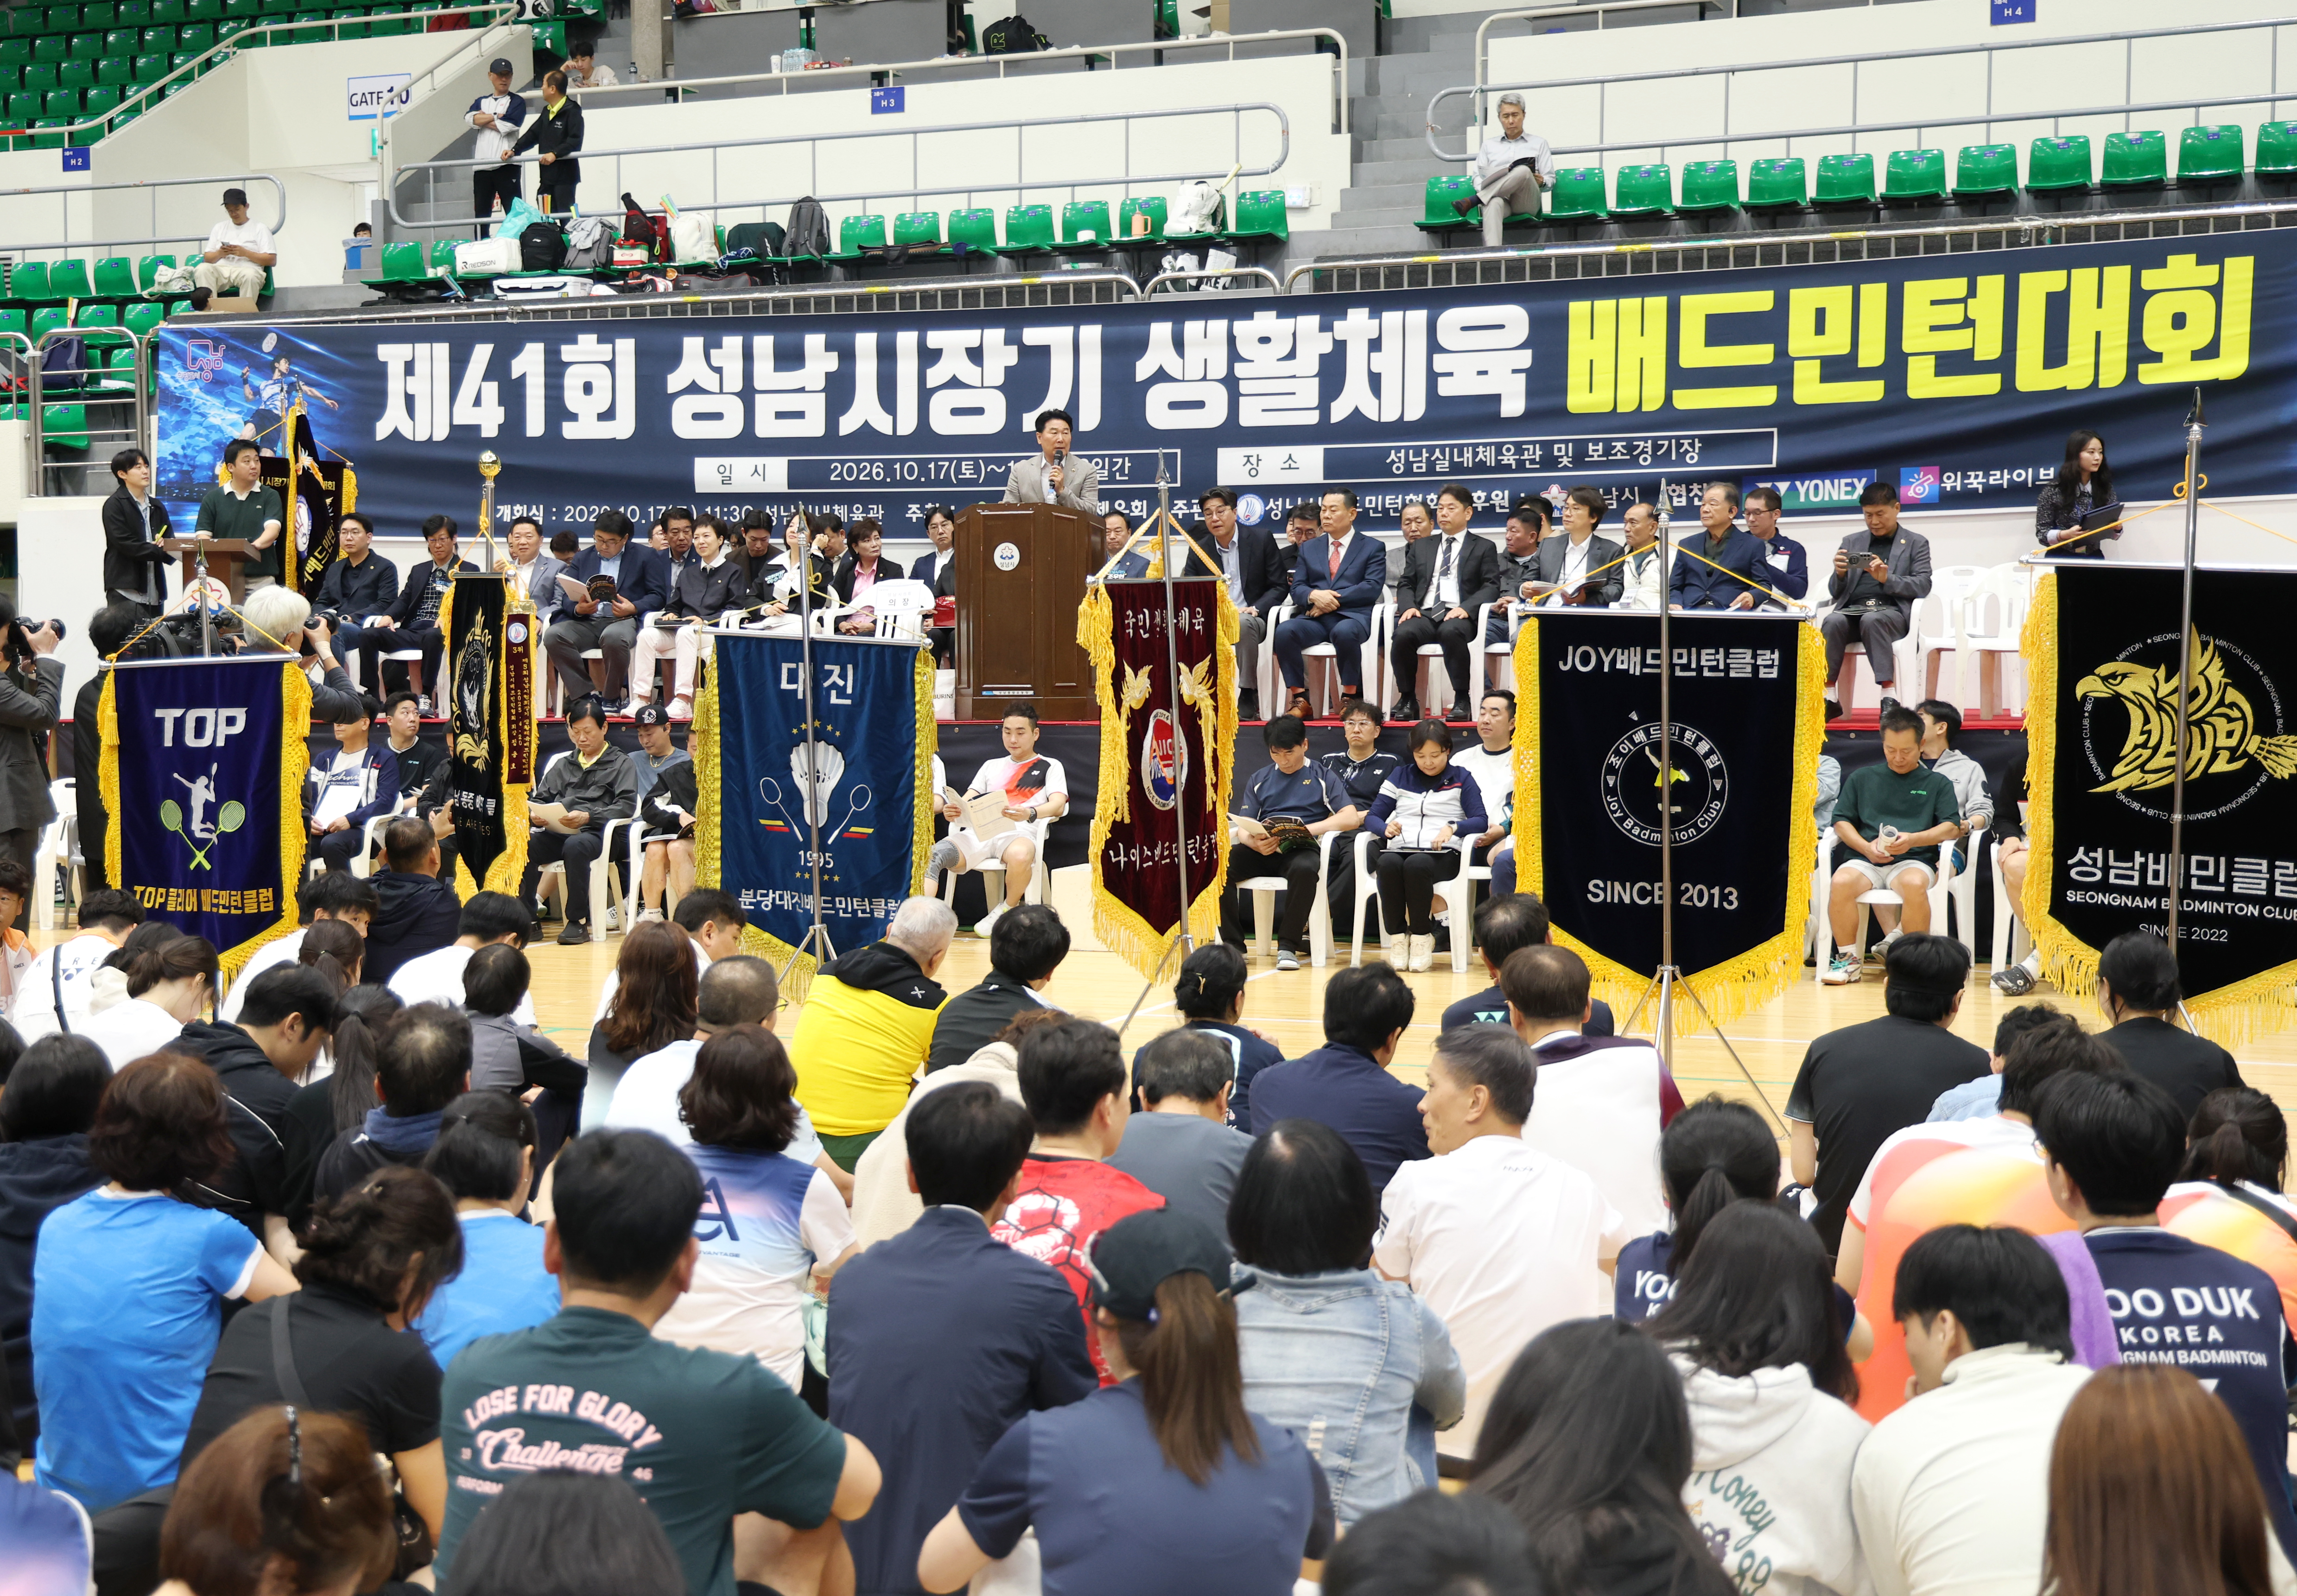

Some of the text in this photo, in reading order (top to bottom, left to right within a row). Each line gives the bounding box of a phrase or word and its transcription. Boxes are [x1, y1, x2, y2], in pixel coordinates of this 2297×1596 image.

[2004, 7, 2023, 17] H 4
[350, 92, 384, 107] GATE
[881, 99, 895, 108] H 3
[468, 259, 496, 269] REDSON
[376, 253, 2255, 442] 제41회 성남시장기 생활체육 배드민턴대회
[1081, 456, 1131, 481] 일간
[1385, 438, 1702, 474] 성남실내체육관 및 보조경기장
[1603, 486, 1639, 509] 남시
[1795, 477, 1868, 502] YONEX
[496, 504, 544, 525] 개회식
[513, 646, 524, 654] 3위
[1558, 645, 1779, 678] JOY배드민턴클럽
[155, 707, 248, 747] TOP
[1606, 794, 1722, 843] Joy Badmnton Club
[200, 887, 274, 915] 배드민턴클럽
[1587, 879, 1739, 910] SINCE 2013
[2066, 890, 2157, 909] SEONGNAM
[2161, 897, 2259, 917] BDMINTON
[2191, 927, 2228, 942] 2022
[2103, 1286, 2260, 1320] OO DUK
[2119, 1325, 2224, 1345] KOREA
[2176, 1349, 2267, 1368] BADMINTON
[463, 1383, 663, 1450] LOSE FOR GLORY
[475, 1427, 626, 1474] Challenge
